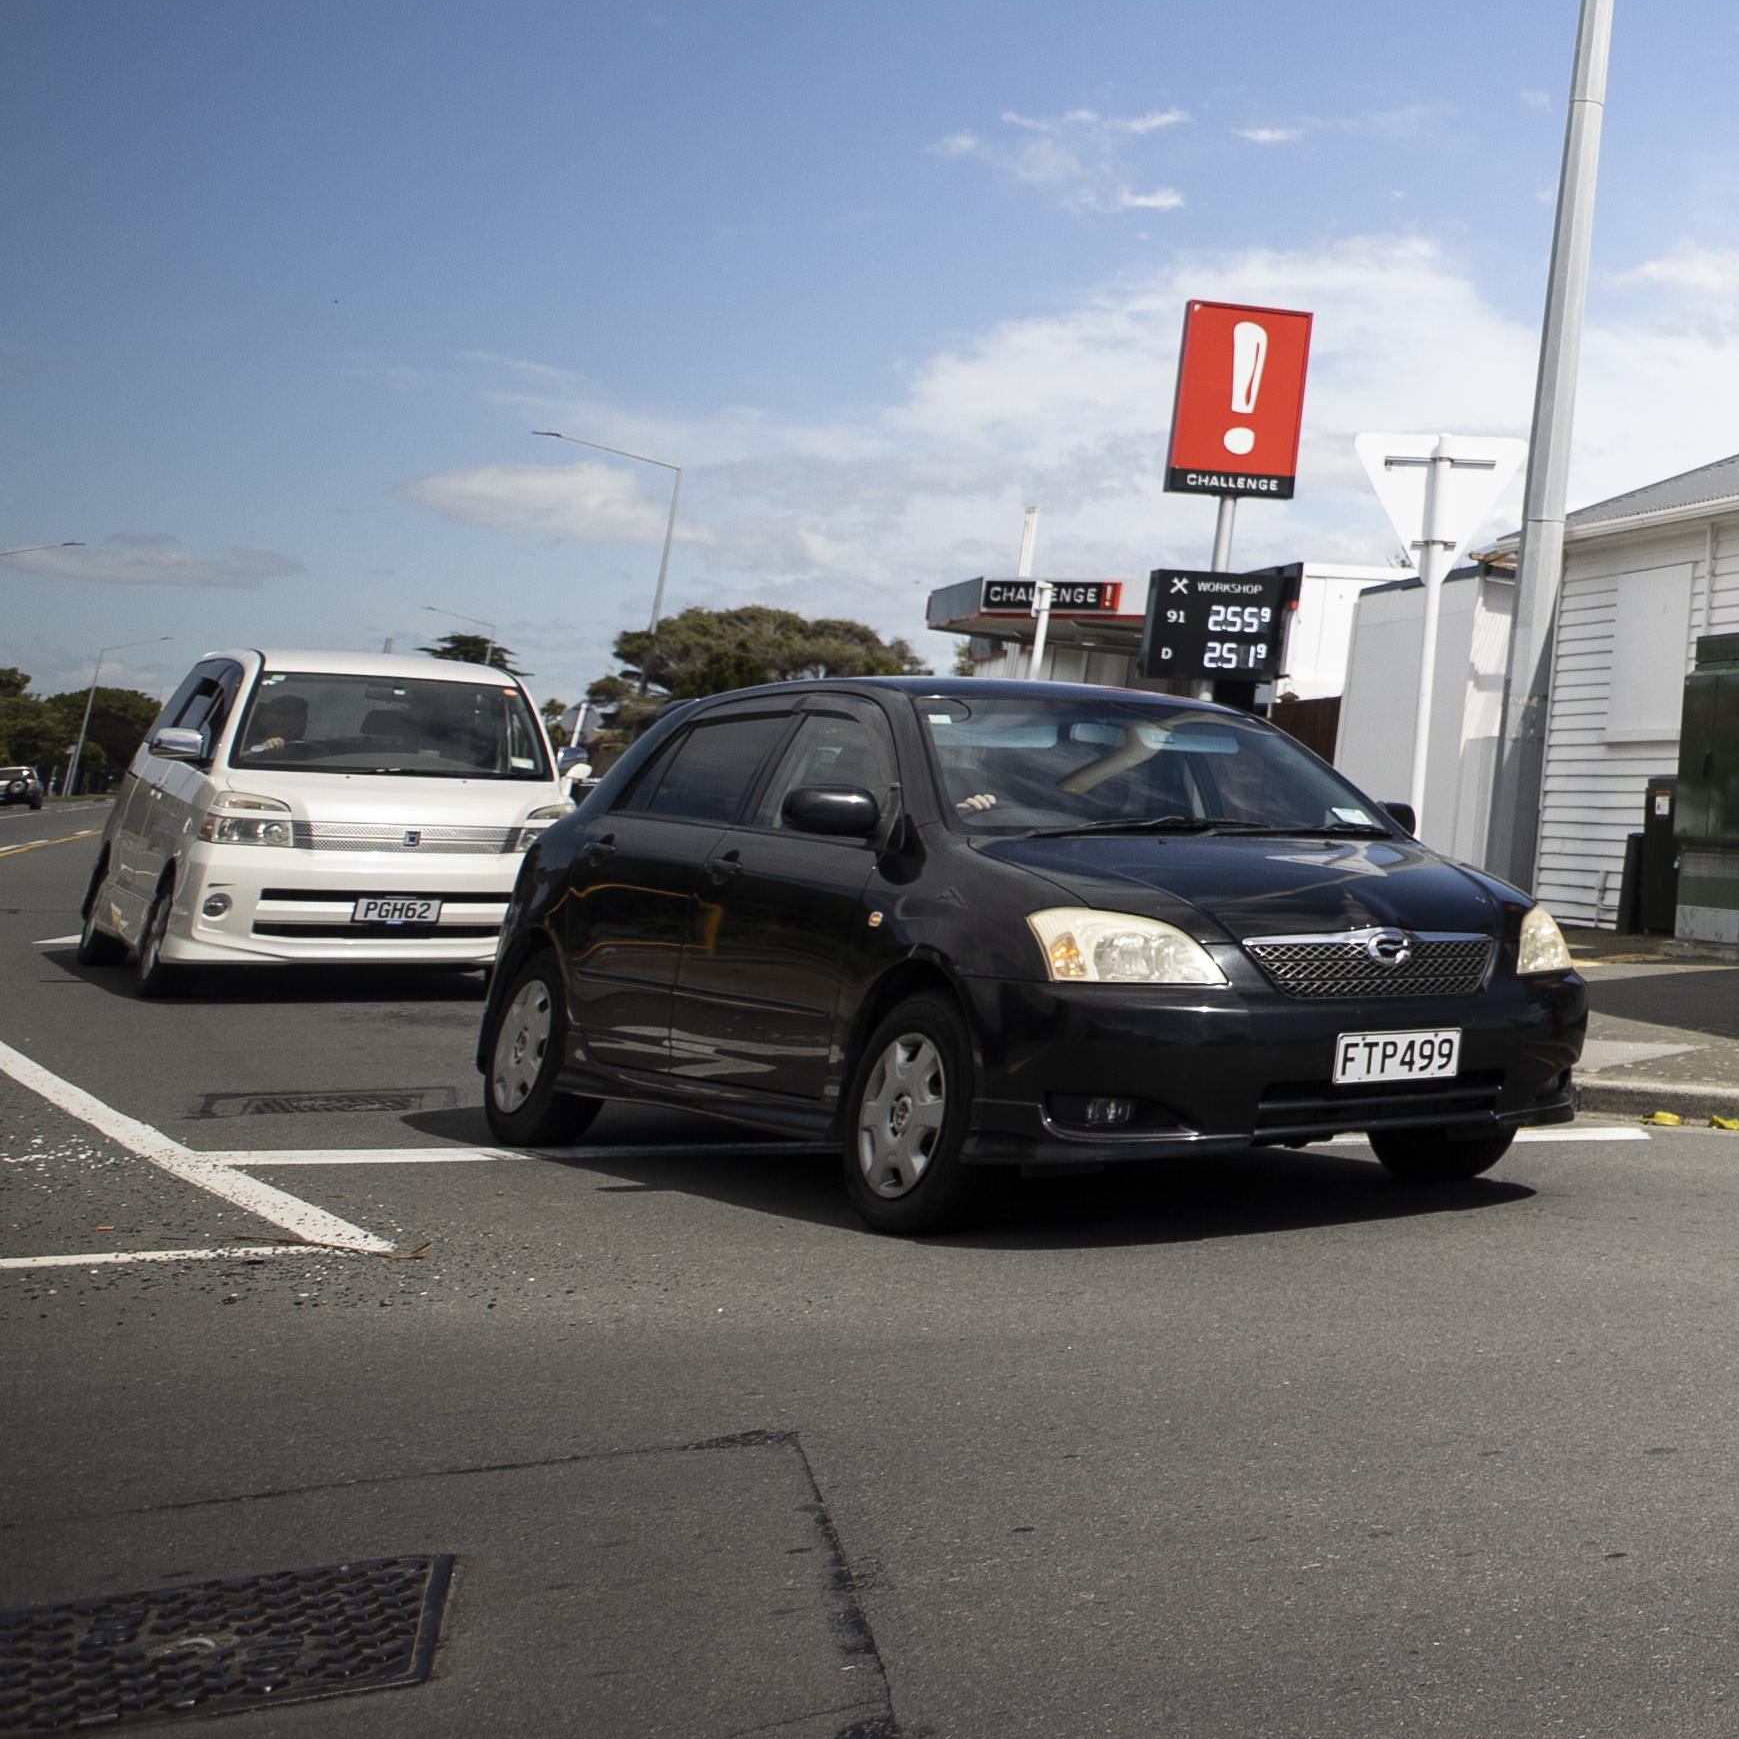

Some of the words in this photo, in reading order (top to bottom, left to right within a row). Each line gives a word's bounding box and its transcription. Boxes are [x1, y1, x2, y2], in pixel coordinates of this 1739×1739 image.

[1186, 473, 1279, 492] CHALLENGE
[989, 586, 1098, 604] CHALENGE
[1197, 581, 1263, 595] WORKSHOP
[1166, 610, 1186, 624] 91
[1161, 647, 1173, 660] D
[363, 901, 432, 920] PGH62
[1341, 1038, 1454, 1076] FTP499
